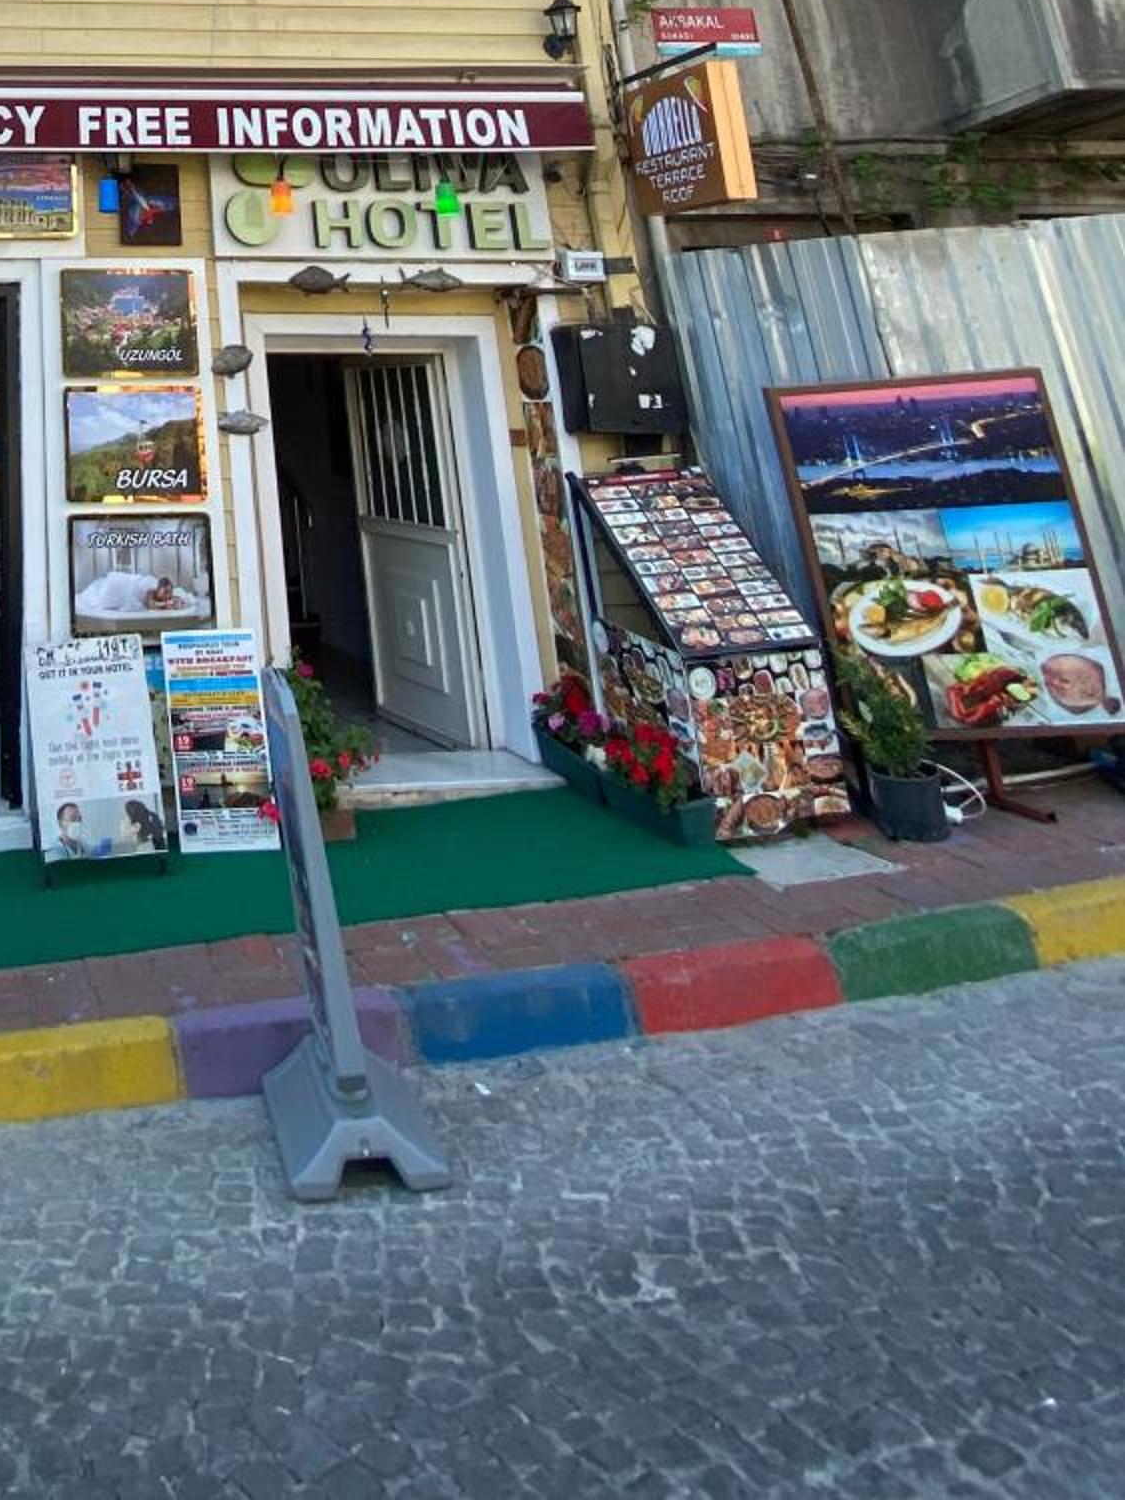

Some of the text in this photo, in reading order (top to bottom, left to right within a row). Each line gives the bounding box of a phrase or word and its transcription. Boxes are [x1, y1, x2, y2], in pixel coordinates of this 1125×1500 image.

[78, 106, 192, 146] FREE
[217, 107, 530, 147] INFORMATION
[650, 164, 706, 189] TERRACE
[663, 185, 694, 203] ROOF
[312, 199, 552, 250] HOTEL
[116, 469, 188, 489] BURSA
